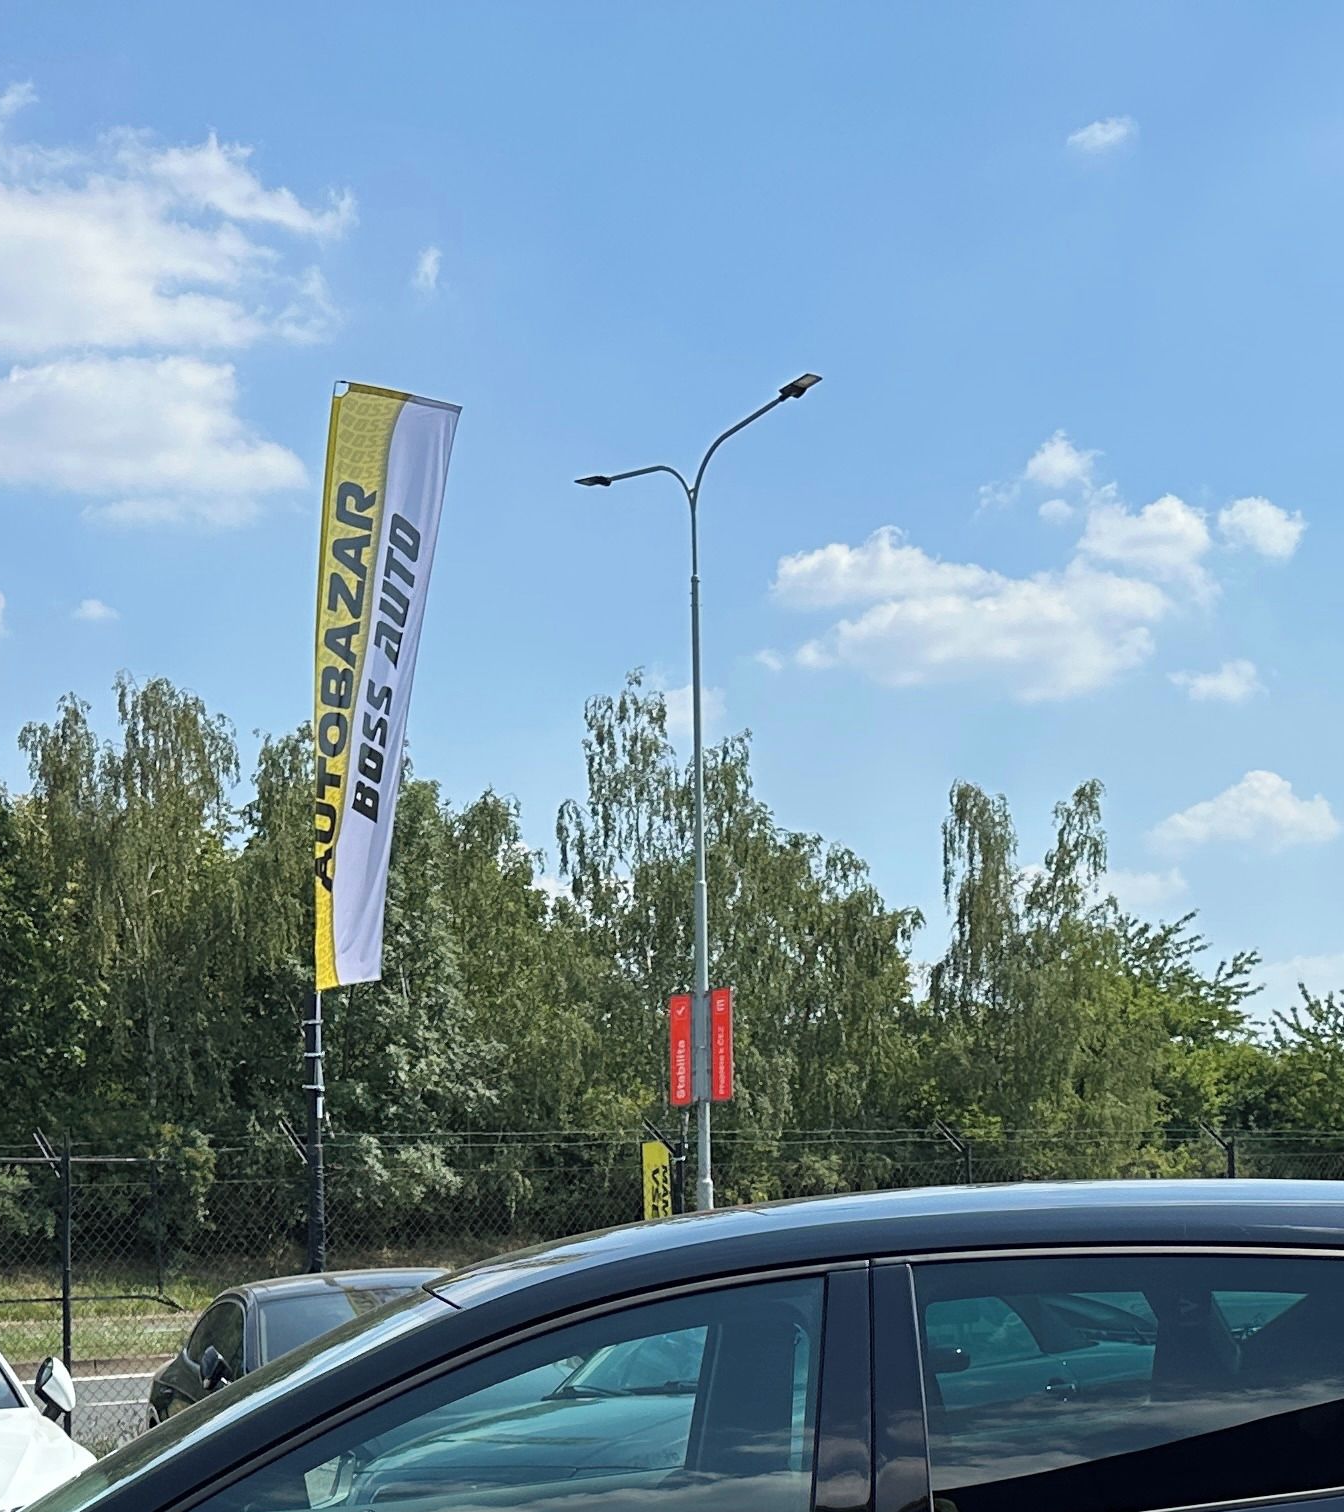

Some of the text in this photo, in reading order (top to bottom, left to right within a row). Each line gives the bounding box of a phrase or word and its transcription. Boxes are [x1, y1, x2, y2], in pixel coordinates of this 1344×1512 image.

[315, 481, 378, 892] AUTOBAZAR
[352, 511, 422, 825] BOSS AUTO
